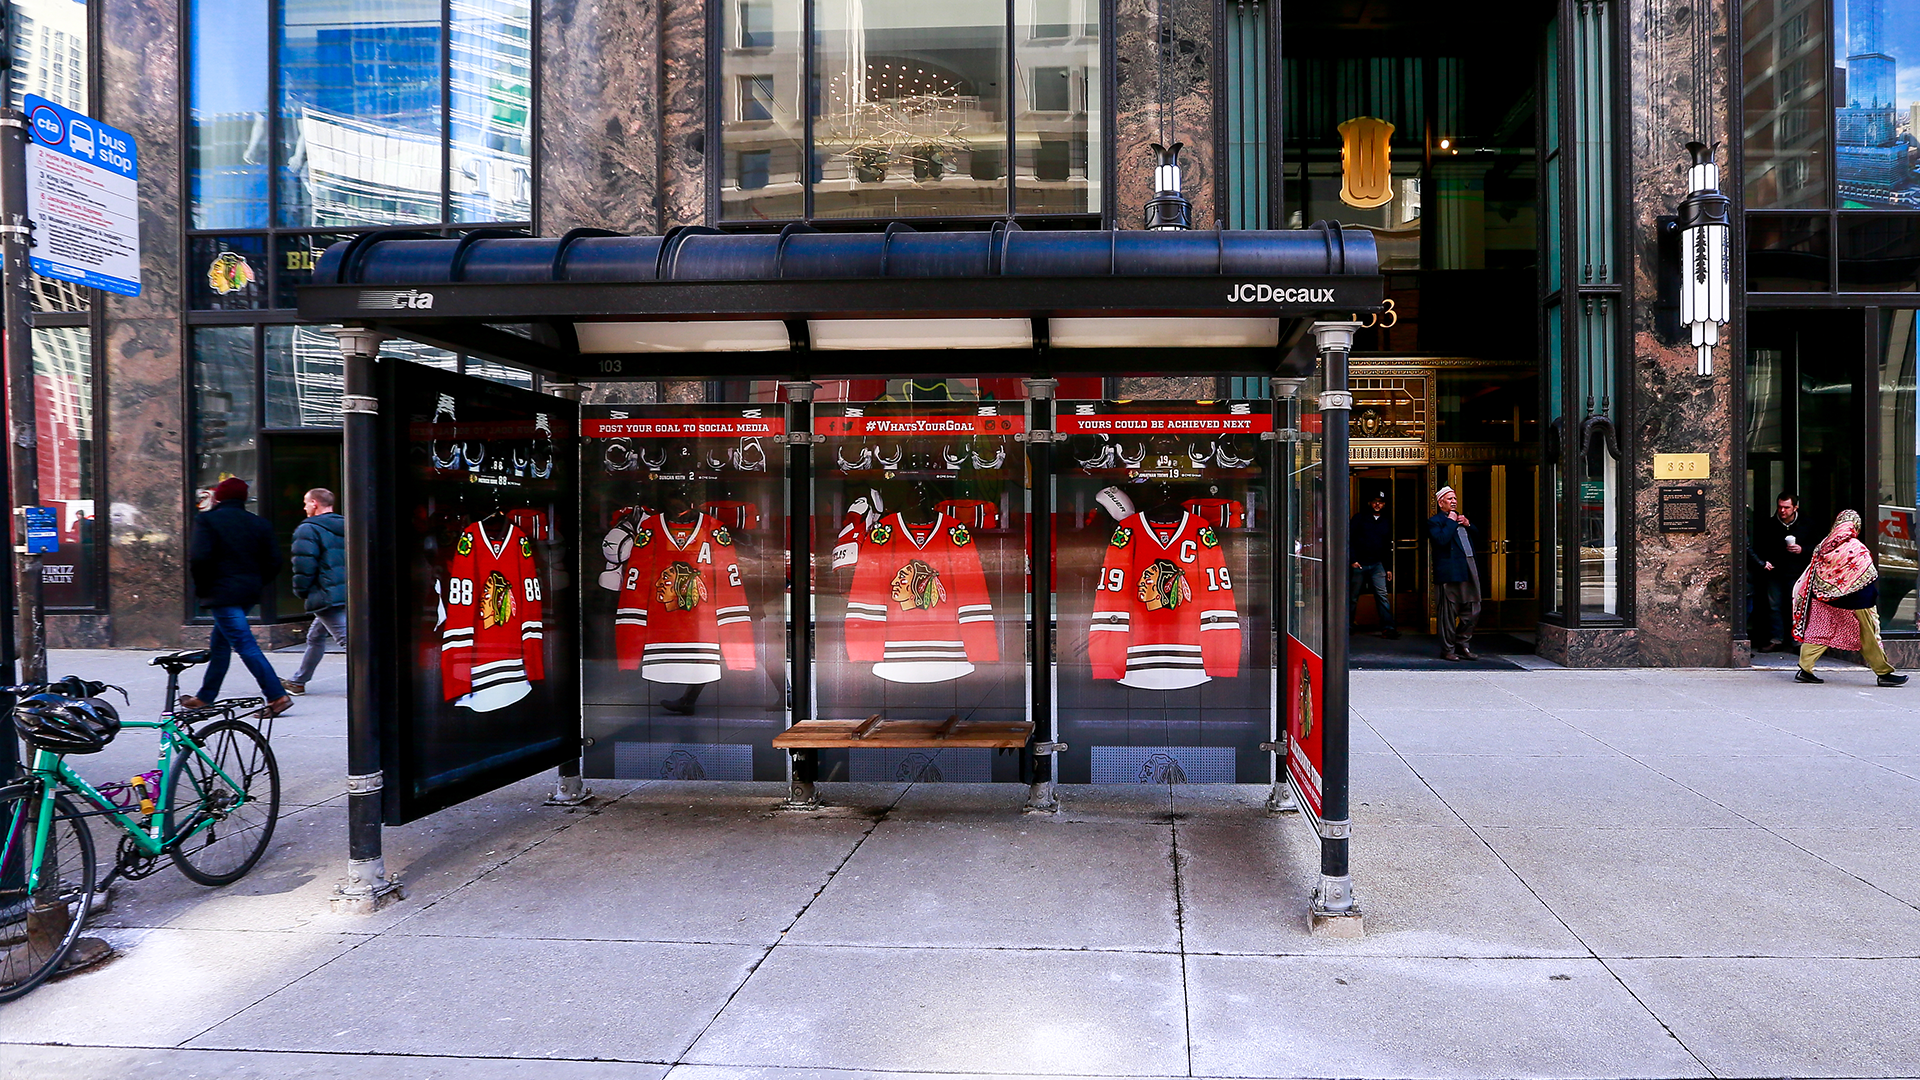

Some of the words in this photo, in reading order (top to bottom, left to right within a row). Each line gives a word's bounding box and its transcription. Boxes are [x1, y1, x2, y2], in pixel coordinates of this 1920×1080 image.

[37, 117, 60, 134] cta
[98, 128, 127, 154] bus
[38, 149, 43, 157] 2
[99, 148, 133, 174] stop
[46, 174, 58, 183] King
[60, 178, 73, 187] Drive
[286, 251, 319, 270] BL
[391, 289, 434, 309] cta
[1227, 284, 1335, 303] JCDecaux
[598, 360, 622, 372] 103
[599, 424, 623, 433] POST
[626, 424, 653, 433] YOUR
[655, 424, 681, 433] GOAL
[684, 424, 696, 432] TO
[698, 424, 733, 432] SOCIAL
[736, 423, 769, 432] MEDIA
[1078, 420, 1112, 429] YOURS
[1115, 420, 1148, 429] COULD
[1151, 420, 1164, 429] BE
[1167, 420, 1220, 429] ACHIEVED
[1223, 420, 1251, 429] NEXT
[1160, 455, 1168, 464] 19
[1667, 461, 1696, 472] 333
[498, 475, 507, 486] 88
[689, 471, 695, 481] 2
[1169, 468, 1179, 478] 19
[697, 542, 712, 564] A
[1180, 540, 1197, 564] C
[42, 575, 74, 584] EALTY
[626, 567, 640, 591] 2
[727, 564, 742, 587] 2
[1097, 567, 1125, 592] 19
[1206, 567, 1233, 592] 19
[449, 577, 474, 606] 88
[524, 578, 542, 602] 88
